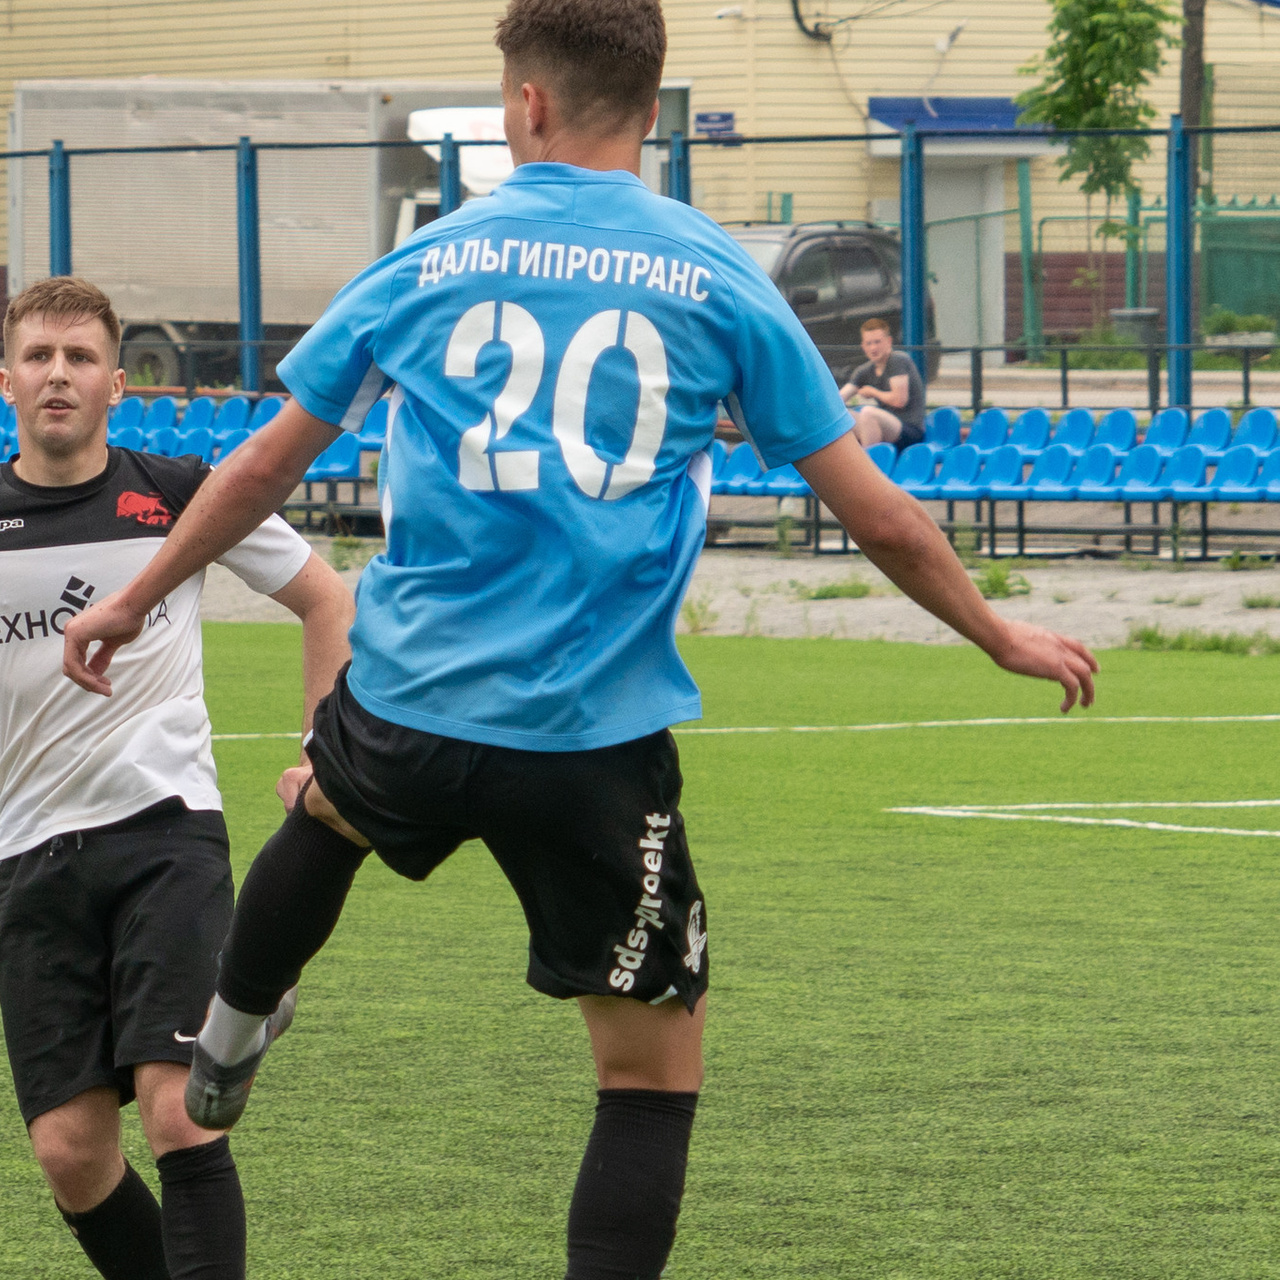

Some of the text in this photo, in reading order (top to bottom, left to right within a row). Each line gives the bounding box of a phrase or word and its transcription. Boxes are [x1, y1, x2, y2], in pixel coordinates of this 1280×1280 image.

[417, 238, 712, 302] ДАЛЬГИПРОТРАНС
[445, 300, 670, 500] 20
[609, 812, 671, 992] sds-proekt
